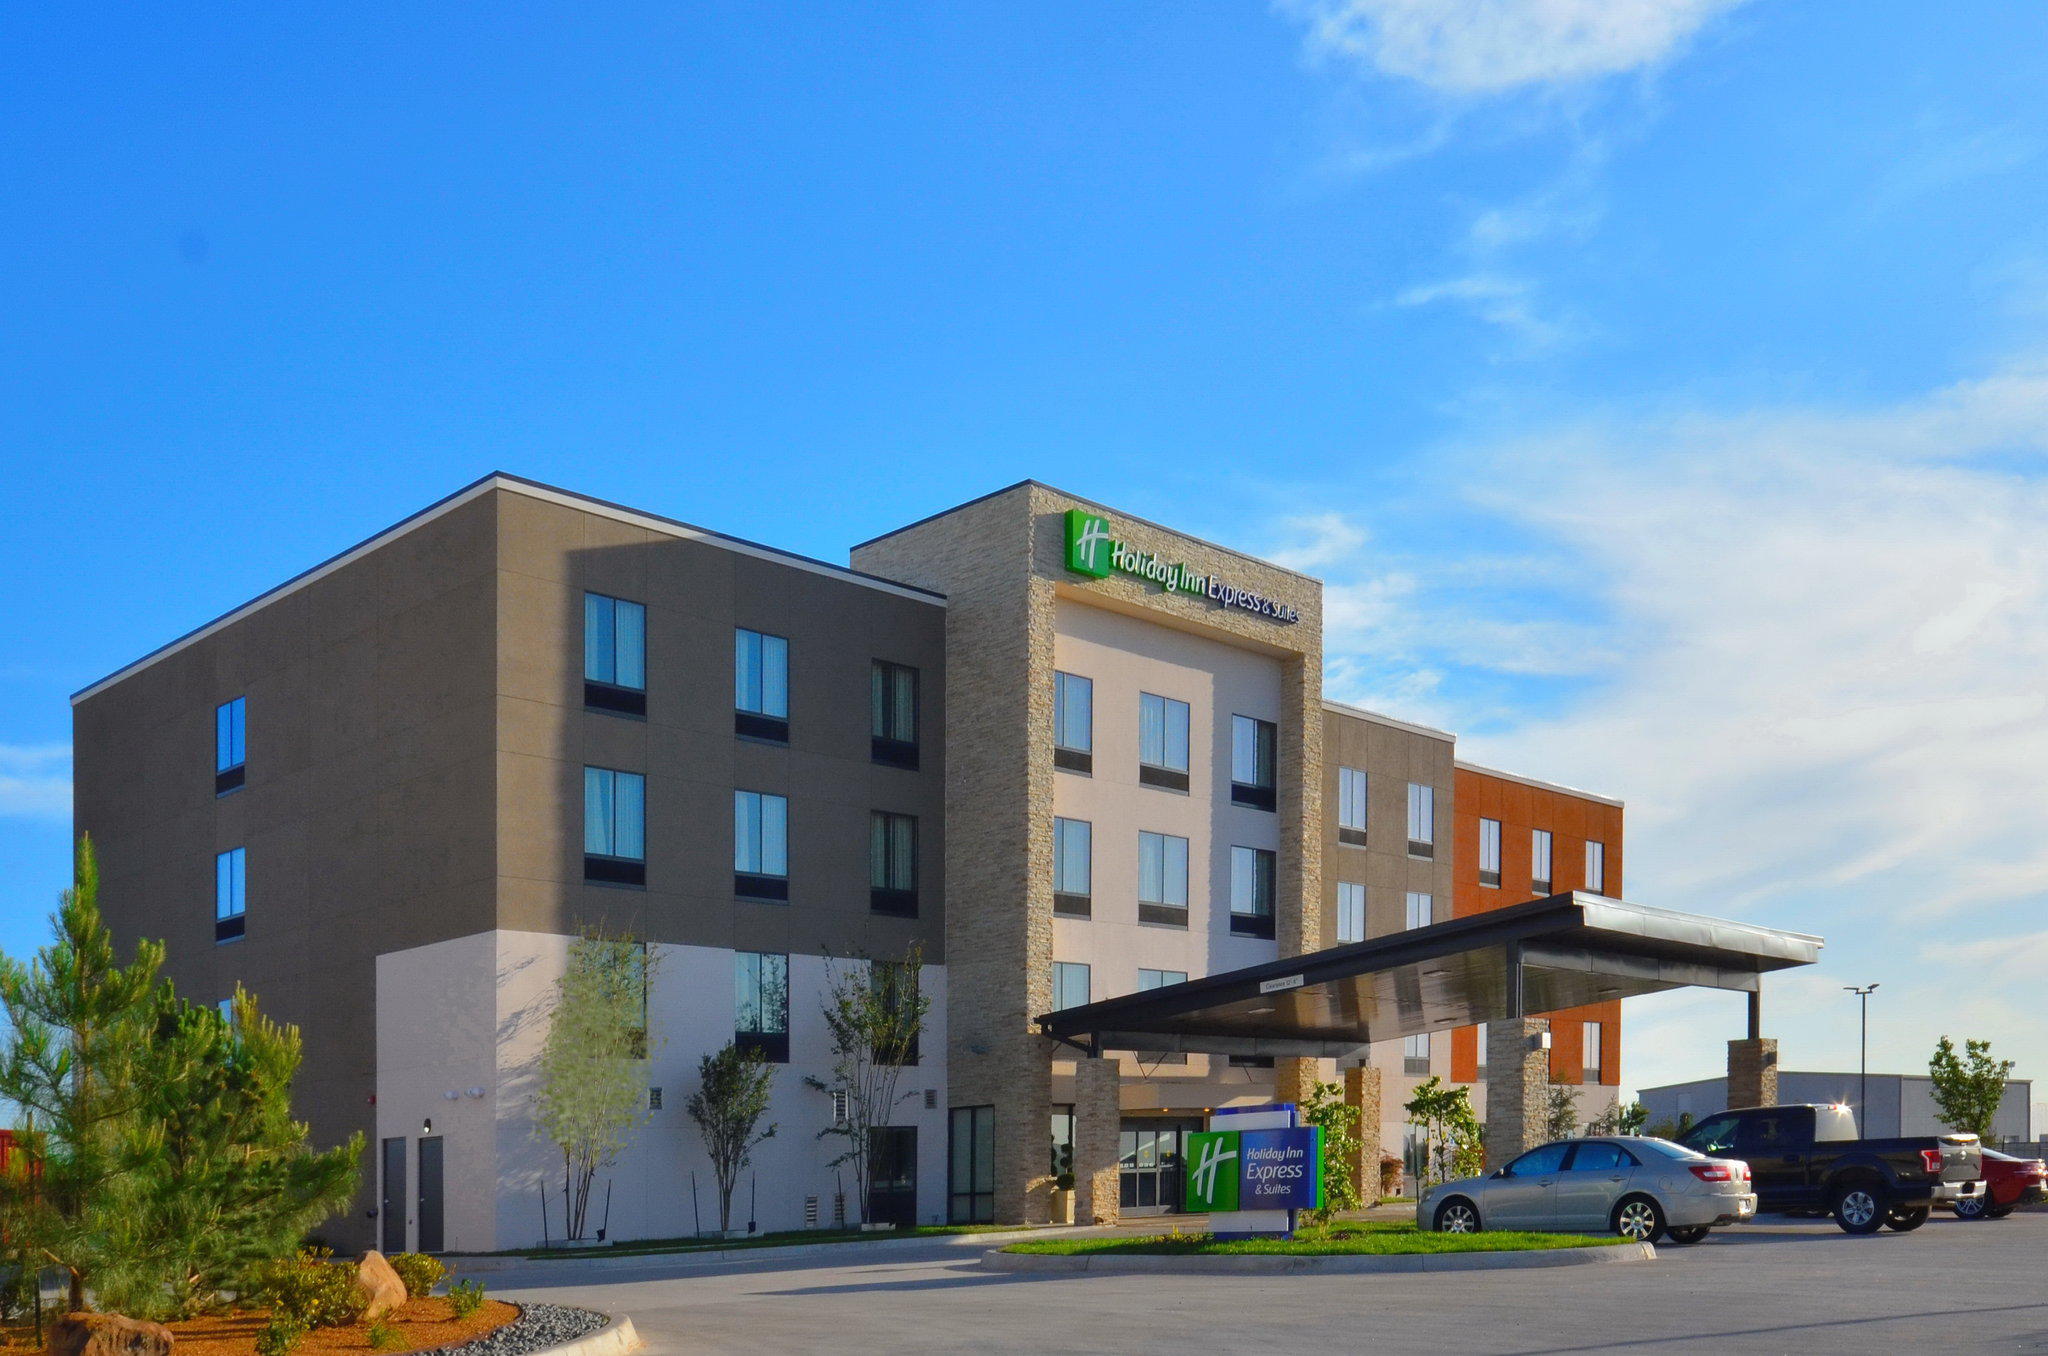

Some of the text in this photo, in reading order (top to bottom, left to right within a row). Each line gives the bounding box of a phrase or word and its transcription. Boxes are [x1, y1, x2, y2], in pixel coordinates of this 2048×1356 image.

[1111, 539, 1300, 623] Holiday Inn Express & Suites
[1246, 1145, 1304, 1162] Holiday Inn
[1246, 1162, 1304, 1183] Express
[1255, 1183, 1291, 1195] & Suites
